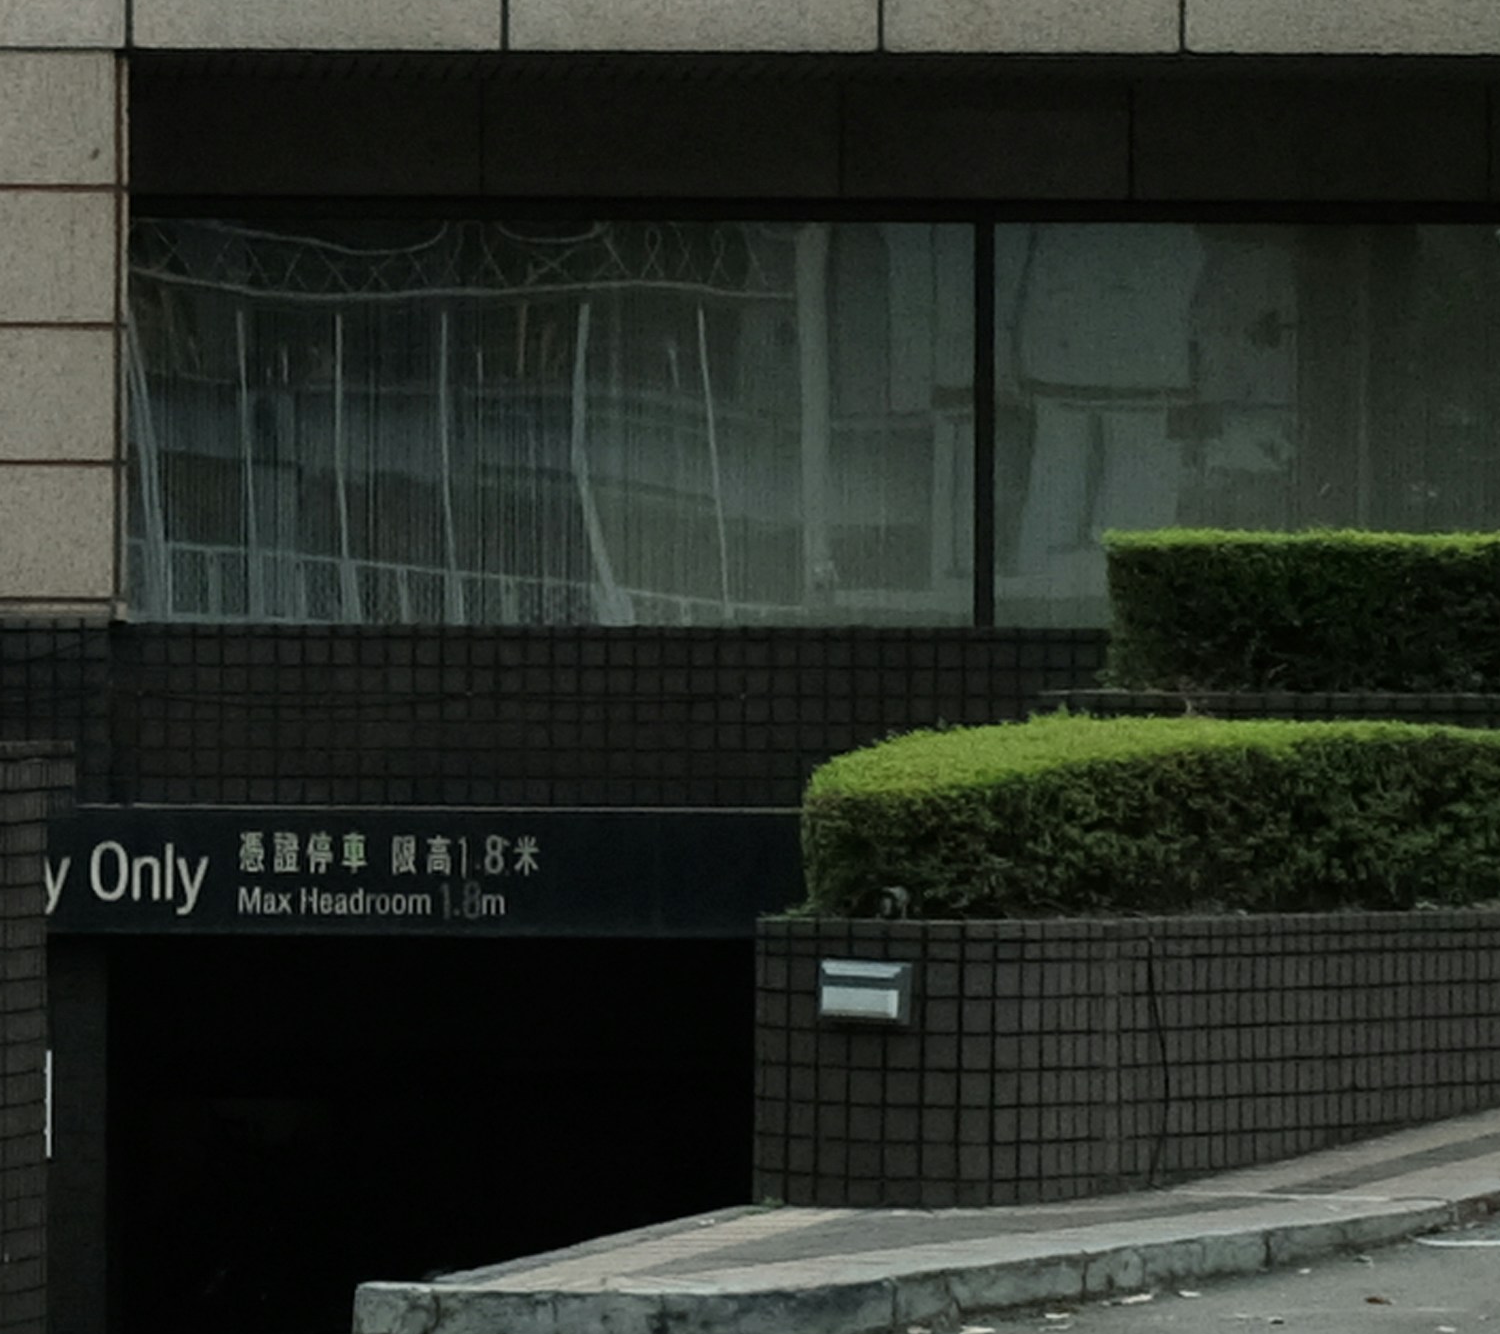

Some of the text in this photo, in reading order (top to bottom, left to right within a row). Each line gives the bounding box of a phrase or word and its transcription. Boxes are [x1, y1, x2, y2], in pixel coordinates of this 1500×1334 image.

[90, 840, 209, 915] Only
[238, 886, 292, 915] Max
[299, 886, 432, 915] Headroom
